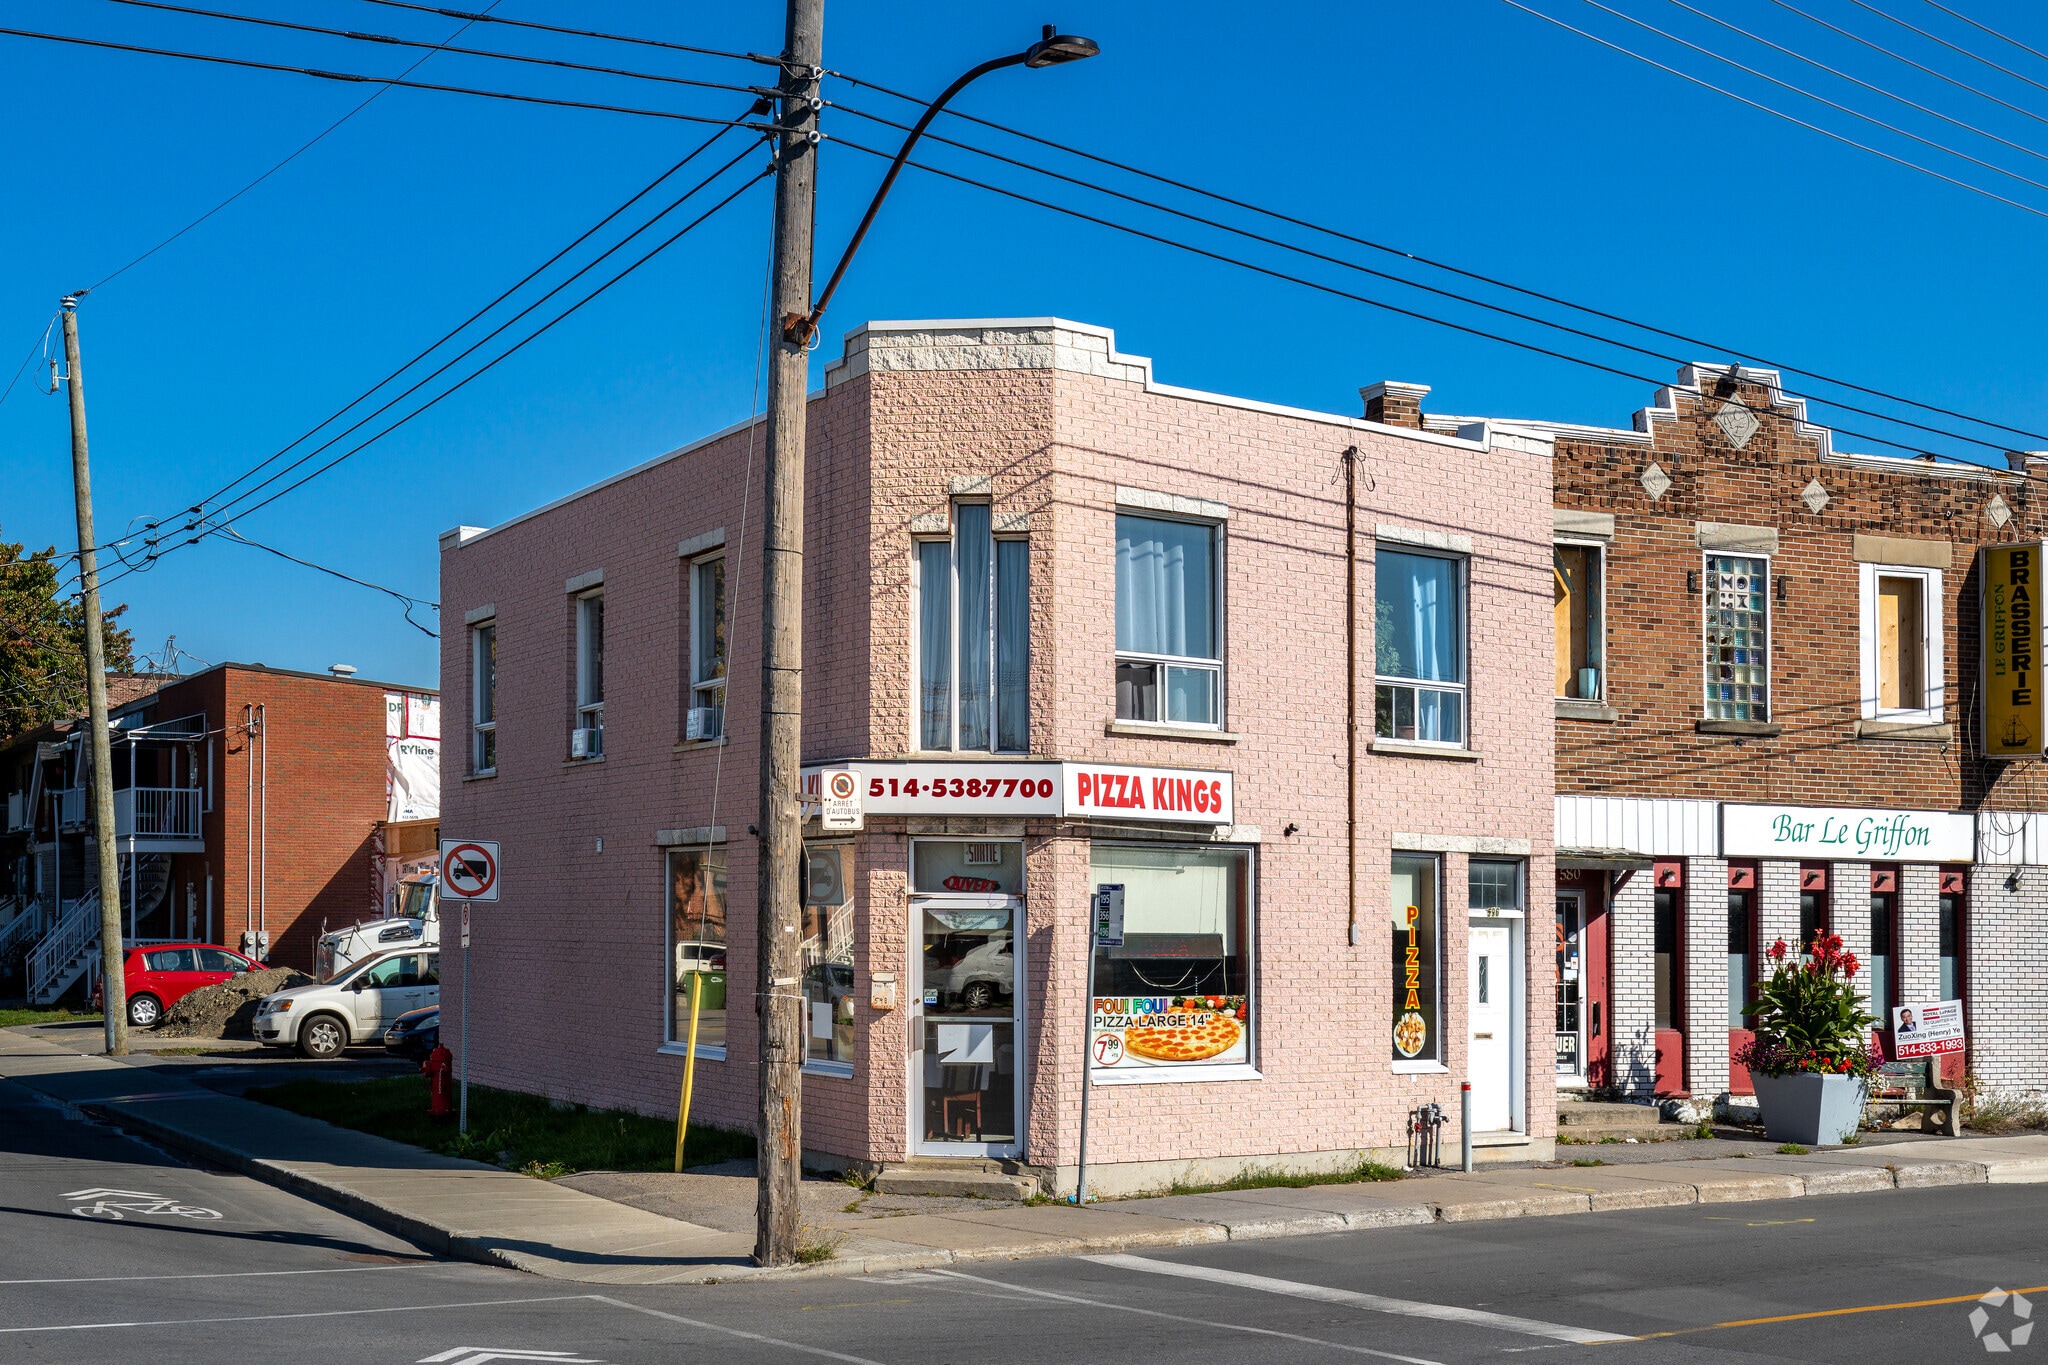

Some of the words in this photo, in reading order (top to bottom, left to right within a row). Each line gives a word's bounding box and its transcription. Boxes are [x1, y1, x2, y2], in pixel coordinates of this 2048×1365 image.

[1994, 584, 2006, 654] GRIFFON
[2010, 550, 2032, 706] BRASSERIE
[1996, 658, 2006, 676] LE
[1077, 772, 1146, 809] PIZZA
[1152, 777, 1222, 814] KINGS
[826, 807, 860, 815] D'AUTOBUS
[1772, 813, 1815, 842] Bar
[1818, 816, 1849, 844] Le
[1855, 814, 1931, 856] Griffon
[968, 844, 998, 862] SORTIE
[1559, 868, 1581, 881] 580
[945, 876, 997, 893] OUVERT
[1099, 911, 1109, 920] 356
[1405, 905, 1421, 1010] PIZZA
[1093, 998, 1129, 1014] FOU!
[1133, 998, 1168, 1014] FOU!
[1093, 1016, 1134, 1028] PIZZA
[1138, 1015, 1186, 1027] LARGE
[1190, 1014, 1211, 1026] 14"
[1898, 1032, 1927, 1040] ZuoXing
[1928, 1028, 1951, 1038] (Henry)
[1097, 1041, 1107, 1060] 7
[1107, 1039, 1119, 1050] 99
[1898, 1039, 1963, 1056] 514-833-1993
